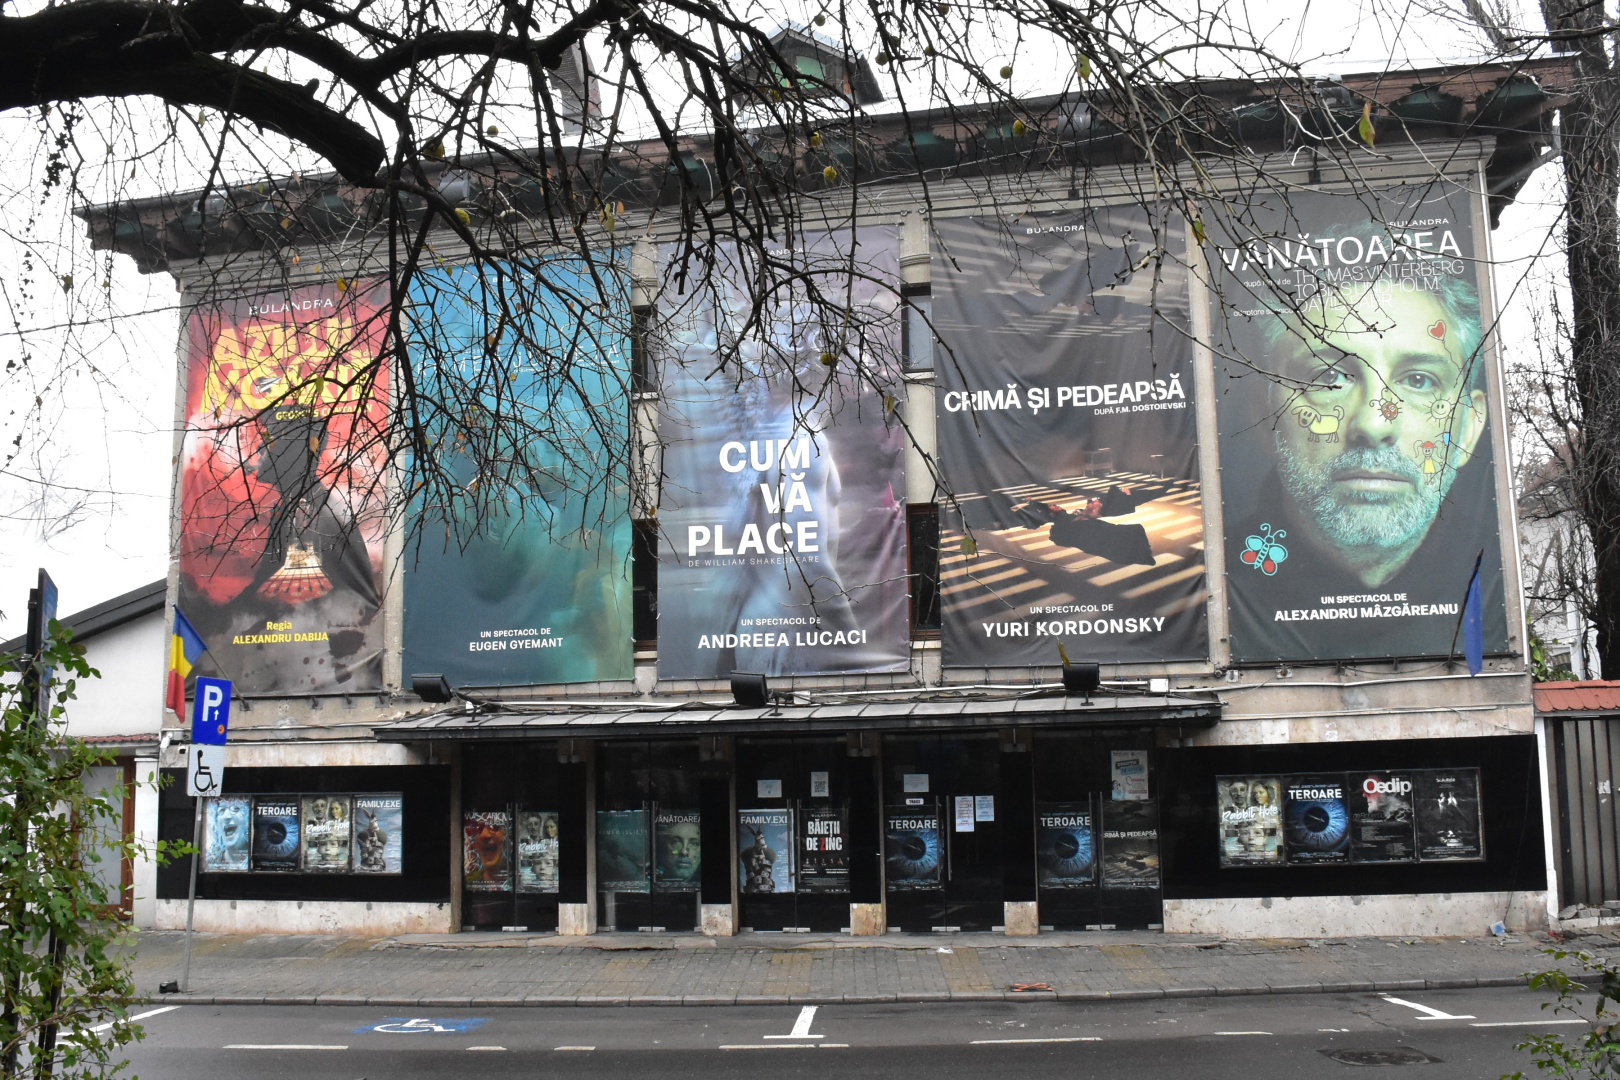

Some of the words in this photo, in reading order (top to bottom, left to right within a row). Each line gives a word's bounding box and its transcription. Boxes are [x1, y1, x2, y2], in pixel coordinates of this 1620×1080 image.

[1026, 224, 1085, 235] BULANDRA
[1389, 218, 1450, 227] BULANDRA
[1218, 230, 1463, 272] VÂNĂTOAREA
[1293, 265, 1364, 284] THOMAS
[1365, 259, 1465, 280] VINTERBERG
[1282, 278, 1292, 286] de
[1354, 275, 1439, 295] LINDHOLM
[248, 298, 334, 316] BULANDRA
[1350, 293, 1393, 310] FARR
[944, 383, 1022, 413] CRIMĂ
[1027, 387, 1050, 415] ȘI
[1057, 373, 1185, 408] PEDEAPSĂ
[1094, 406, 1114, 416] DUPĂ
[1115, 405, 1131, 414] F.M.
[1132, 401, 1186, 412] DOSTOIEVSKI
[719, 437, 811, 473] CUM
[759, 472, 813, 514] VĂ
[687, 520, 820, 557] PLACE
[688, 559, 700, 568] DE
[704, 558, 746, 567] WILLIAM
[749, 555, 820, 566] SHAKESPEARE
[1321, 596, 1335, 605] UN
[1336, 594, 1393, 604] SPECTACOL
[1393, 592, 1408, 602] DE
[1029, 606, 1043, 615] UN
[1045, 604, 1100, 614] SPECTACOL
[1101, 603, 1114, 613] DE
[1274, 607, 1358, 622] ALEXANDRU
[1360, 602, 1459, 619] MÂZGĂREANU
[266, 620, 293, 632] Regia
[741, 618, 754, 626] UN
[755, 617, 807, 626] SPECTACOL
[809, 616, 821, 625] DE
[982, 621, 1030, 638] YURI
[1036, 616, 1166, 637] KORDONSKY
[232, 633, 292, 645] ALEXANDRU
[293, 631, 329, 642] DABIJA
[480, 630, 492, 639] UN
[493, 628, 539, 638] SPECTACOL
[540, 627, 552, 635] DE
[697, 632, 790, 649] ANDREEA
[795, 629, 867, 647] LUCACI
[469, 640, 507, 652] EUGEN
[509, 637, 564, 650] GYEMANT
[201, 685, 223, 722] P
[1288, 788, 1343, 800] TEROARE
[1362, 777, 1412, 796] Oedip
[257, 806, 298, 816] TEROARE
[357, 800, 401, 809] FAMILY.EXE
[807, 818, 840, 837] BĂIEȚII
[888, 819, 937, 830] TEROARE
[1040, 816, 1091, 827] TEROARE
[805, 838, 819, 851] DE
[820, 837, 843, 852] ZINC
